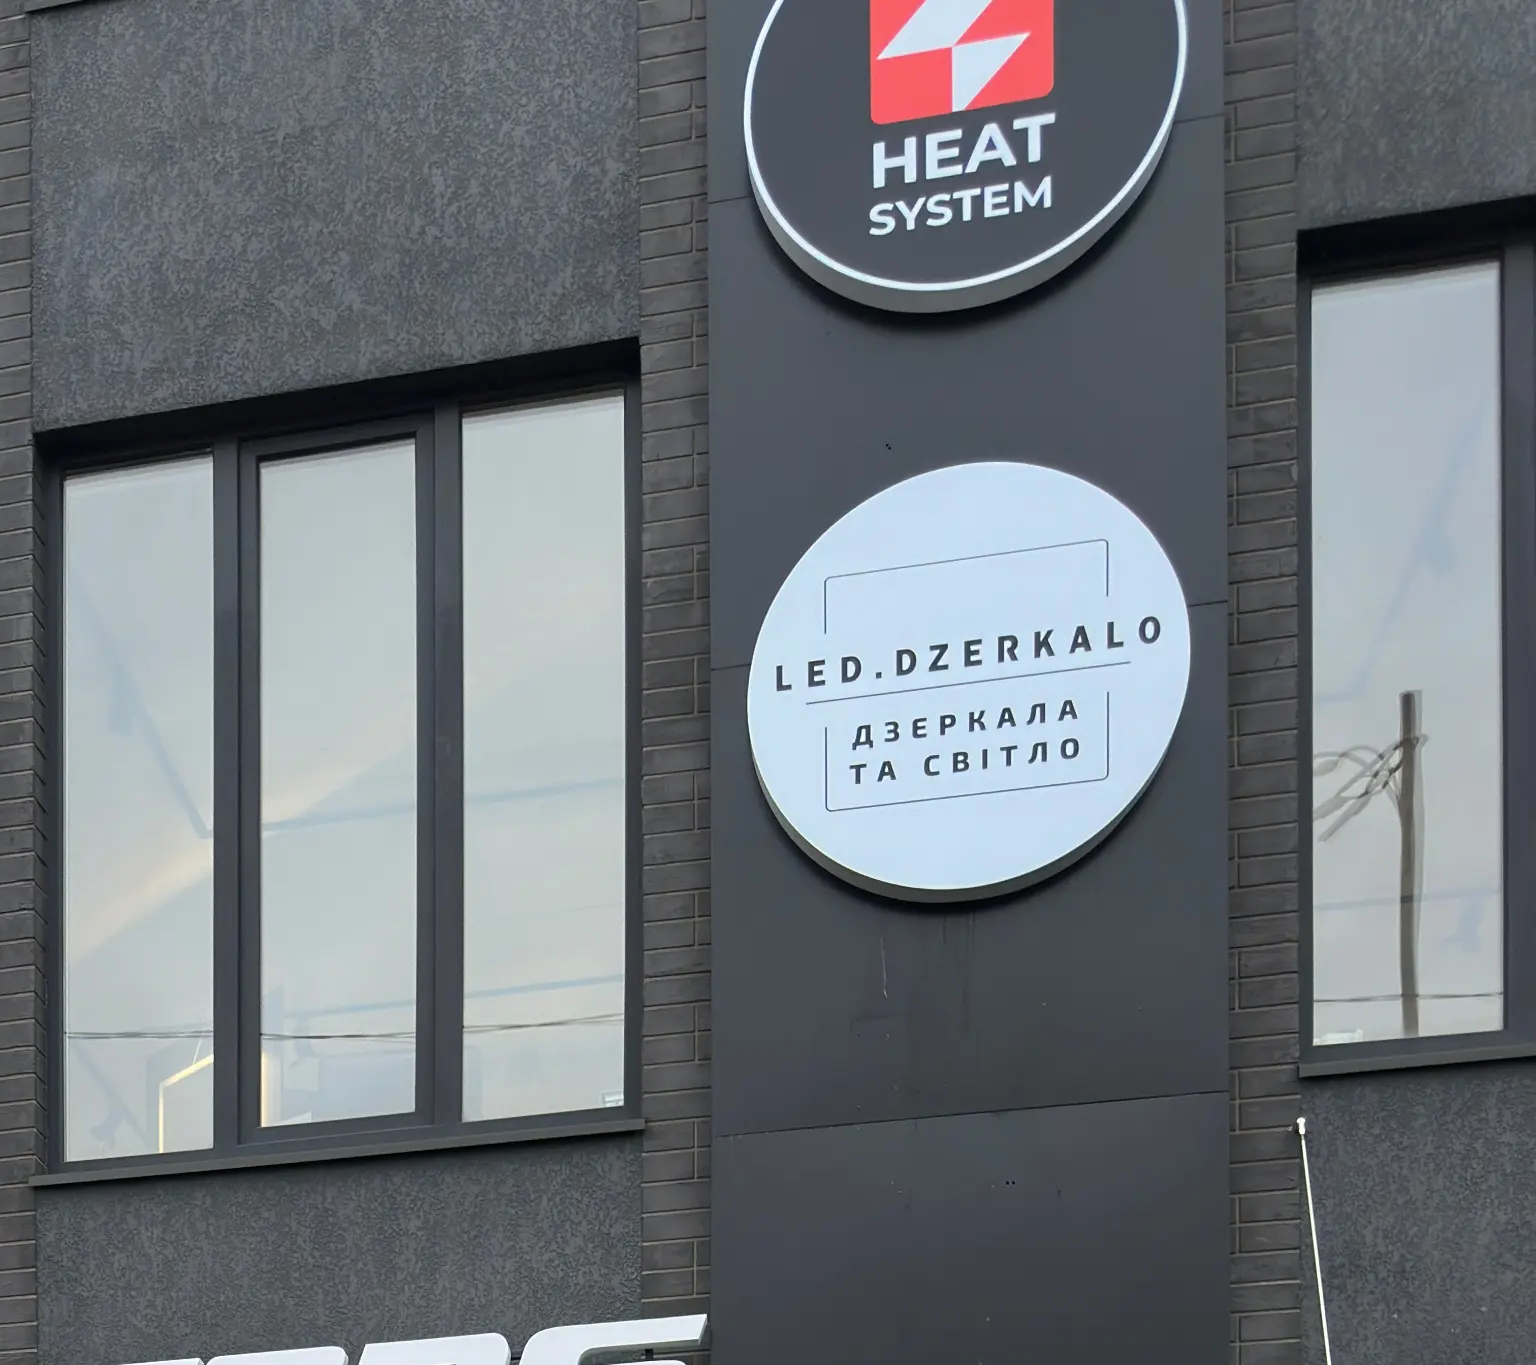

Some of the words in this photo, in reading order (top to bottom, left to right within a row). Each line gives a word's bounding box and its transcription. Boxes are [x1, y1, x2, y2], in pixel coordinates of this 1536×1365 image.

[872, 112, 1056, 189] HEAT
[868, 175, 1054, 237] SYSTEM
[775, 616, 1162, 692] LED.DZERKALO
[851, 699, 1078, 751] ДЗЕРКАЛА
[849, 760, 897, 785] ТА
[923, 737, 1080, 777] СВІТЛО
